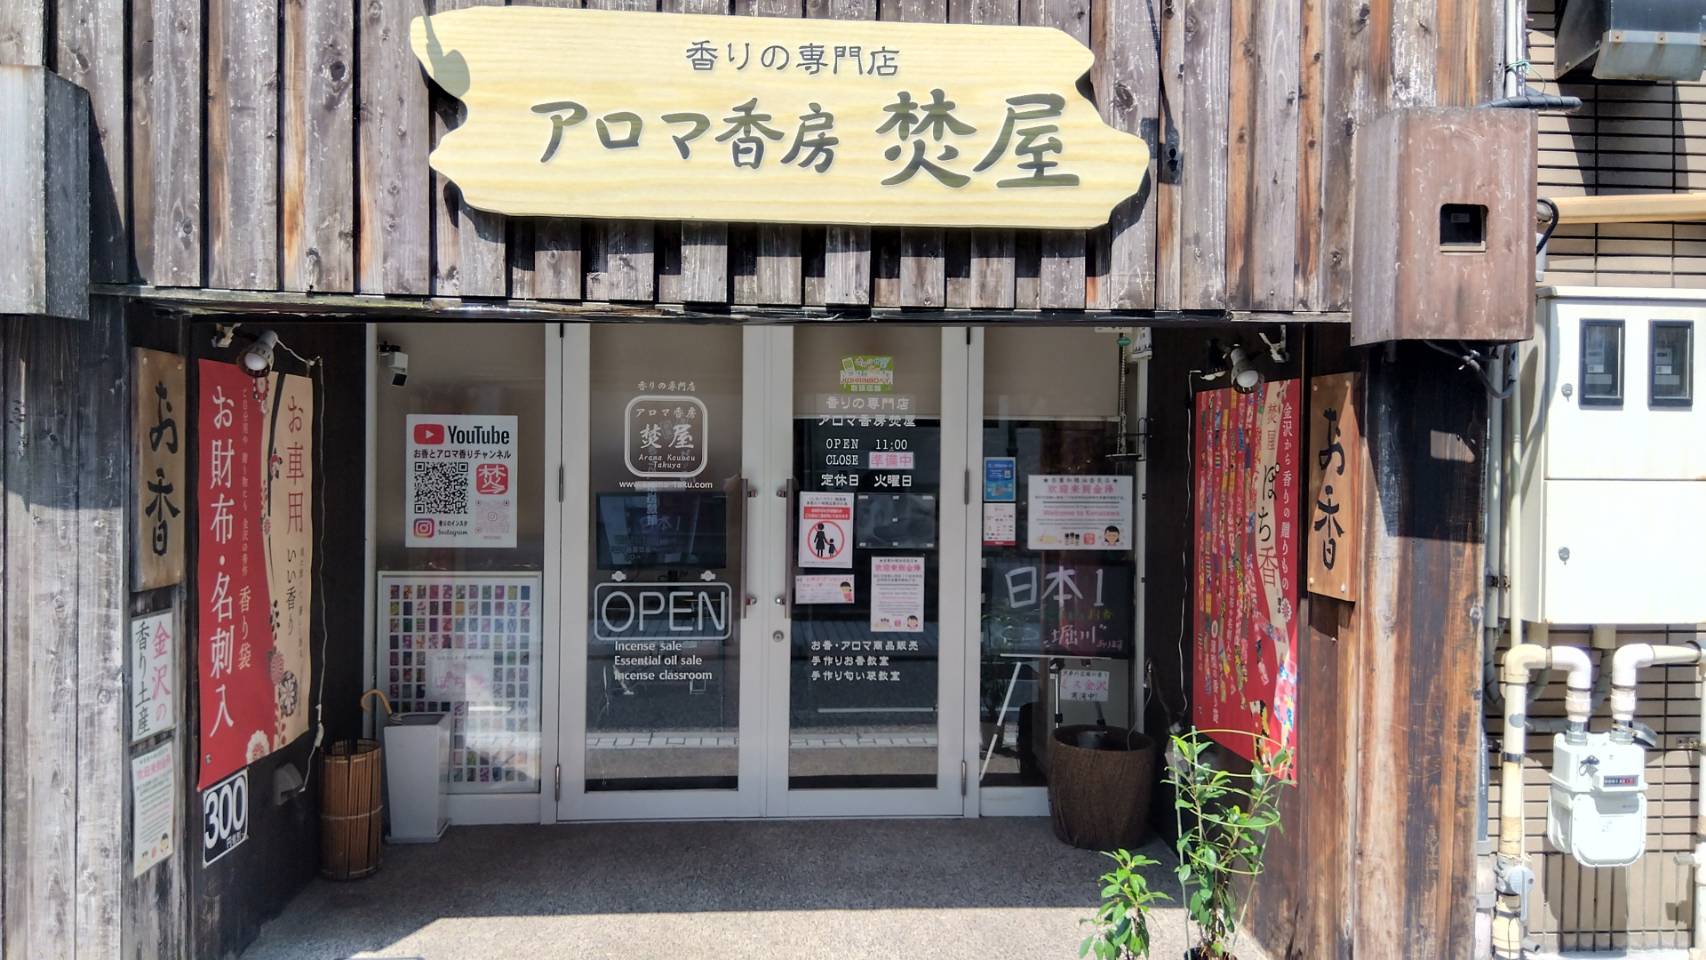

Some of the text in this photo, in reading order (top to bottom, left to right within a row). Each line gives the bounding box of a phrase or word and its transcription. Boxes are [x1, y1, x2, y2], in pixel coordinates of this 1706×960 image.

[685, 40, 901, 77] 香りの専門店
[531, 88, 1080, 188] アロマ香房 焚屋
[638, 380, 696, 391] 香りの専門店
[826, 396, 910, 410] 香りの専門店
[636, 407, 697, 418] アロマ香房
[819, 415, 916, 427] アロマ香房焚屋
[448, 425, 510, 445] YouTube
[640, 423, 694, 449] 焚屋
[826, 439, 908, 450] OPEN 11:00
[414, 449, 511, 460] お香とアロマ香りチャンネル
[826, 455, 859, 465] CLOSE
[871, 452, 913, 466] 準備中
[145, 380, 181, 557] お香
[286, 395, 304, 535] お車用
[821, 473, 912, 487] 定休日 火曜日
[1314, 407, 1347, 571] お香
[1279, 402, 1294, 591] 金沢から香りの贈りもの
[209, 385, 236, 738] お財布・名刺入
[601, 591, 725, 632] OPEN
[615, 641, 682, 651] Incense sale
[811, 640, 919, 651] お香・アロマ商品販売
[614, 655, 703, 665] Essential oil sale
[811, 656, 890, 666] 手作りお香教室
[135, 621, 150, 736] 香り土産
[151, 621, 171, 722] 金沢の
[614, 670, 712, 680] Incense classroom
[205, 776, 246, 850] 300
